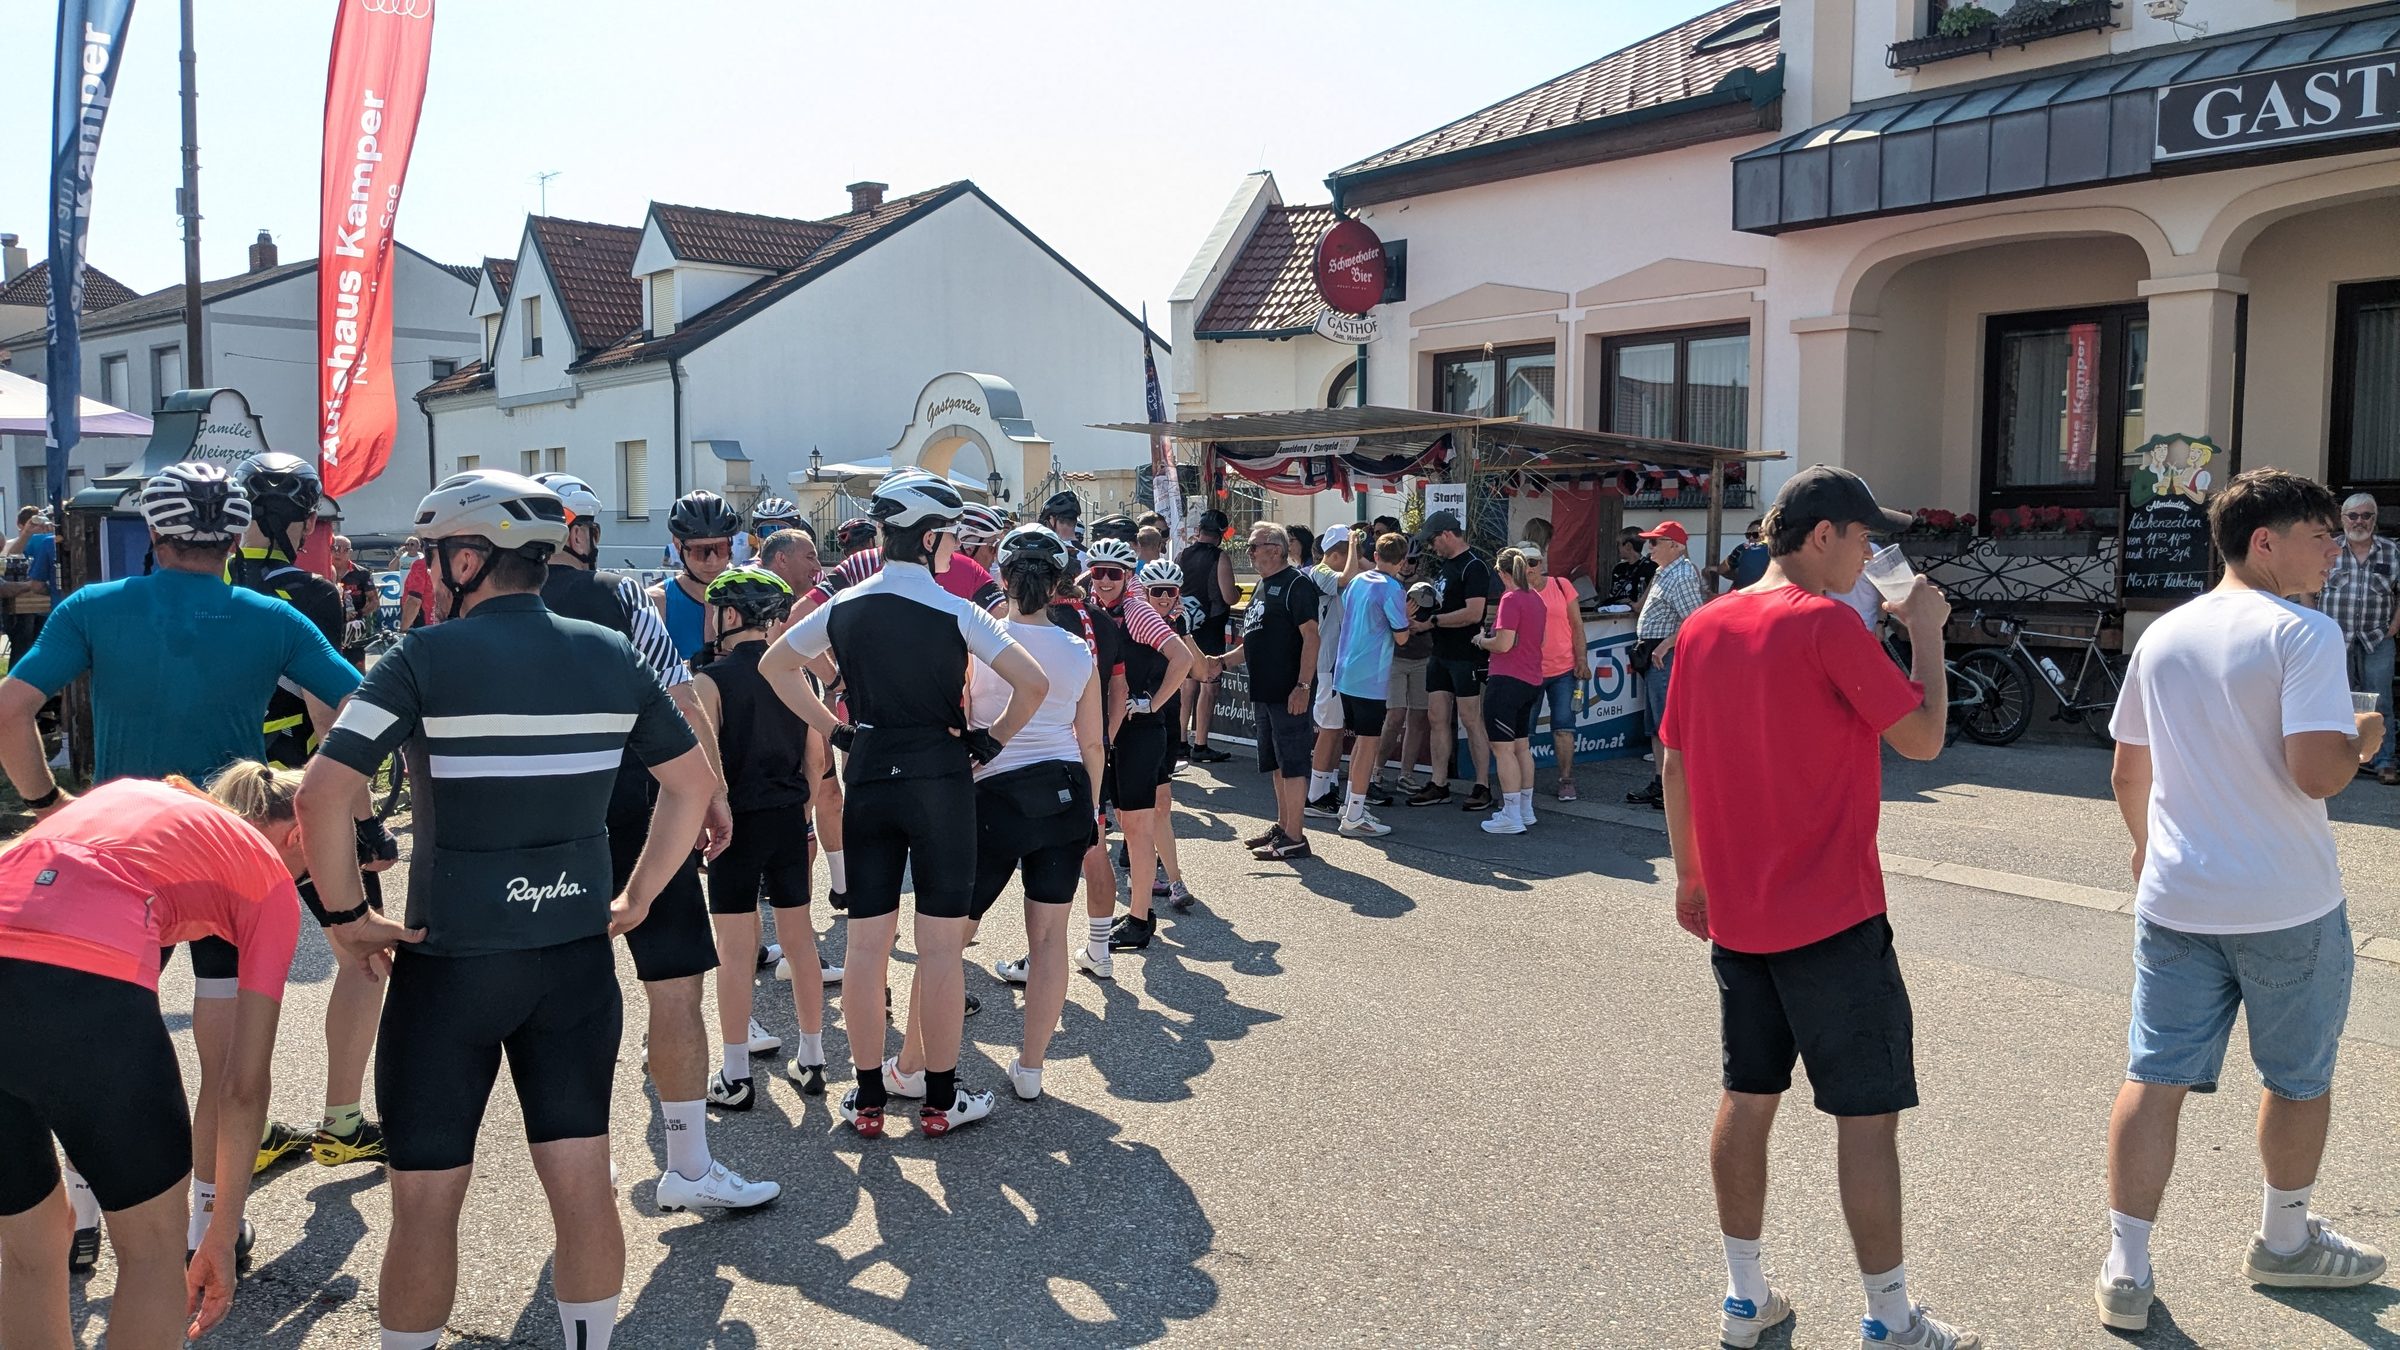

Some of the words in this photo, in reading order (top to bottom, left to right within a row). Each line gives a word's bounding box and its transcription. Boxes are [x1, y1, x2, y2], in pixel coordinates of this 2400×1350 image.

[2193, 62, 2400, 140] GAST
[335, 89, 385, 259] Kamper
[380, 183, 400, 230] See
[1351, 266, 1373, 283] Bier
[1327, 317, 1378, 335] GASTHOF
[927, 396, 981, 428] Gastgarten
[198, 419, 252, 440] Familie
[191, 443, 266, 465] Weinzett
[2125, 548, 2143, 559] und
[1596, 705, 1623, 717] GMBH
[506, 871, 587, 913] Rapha.
[664, 1123, 688, 1131] ADE
